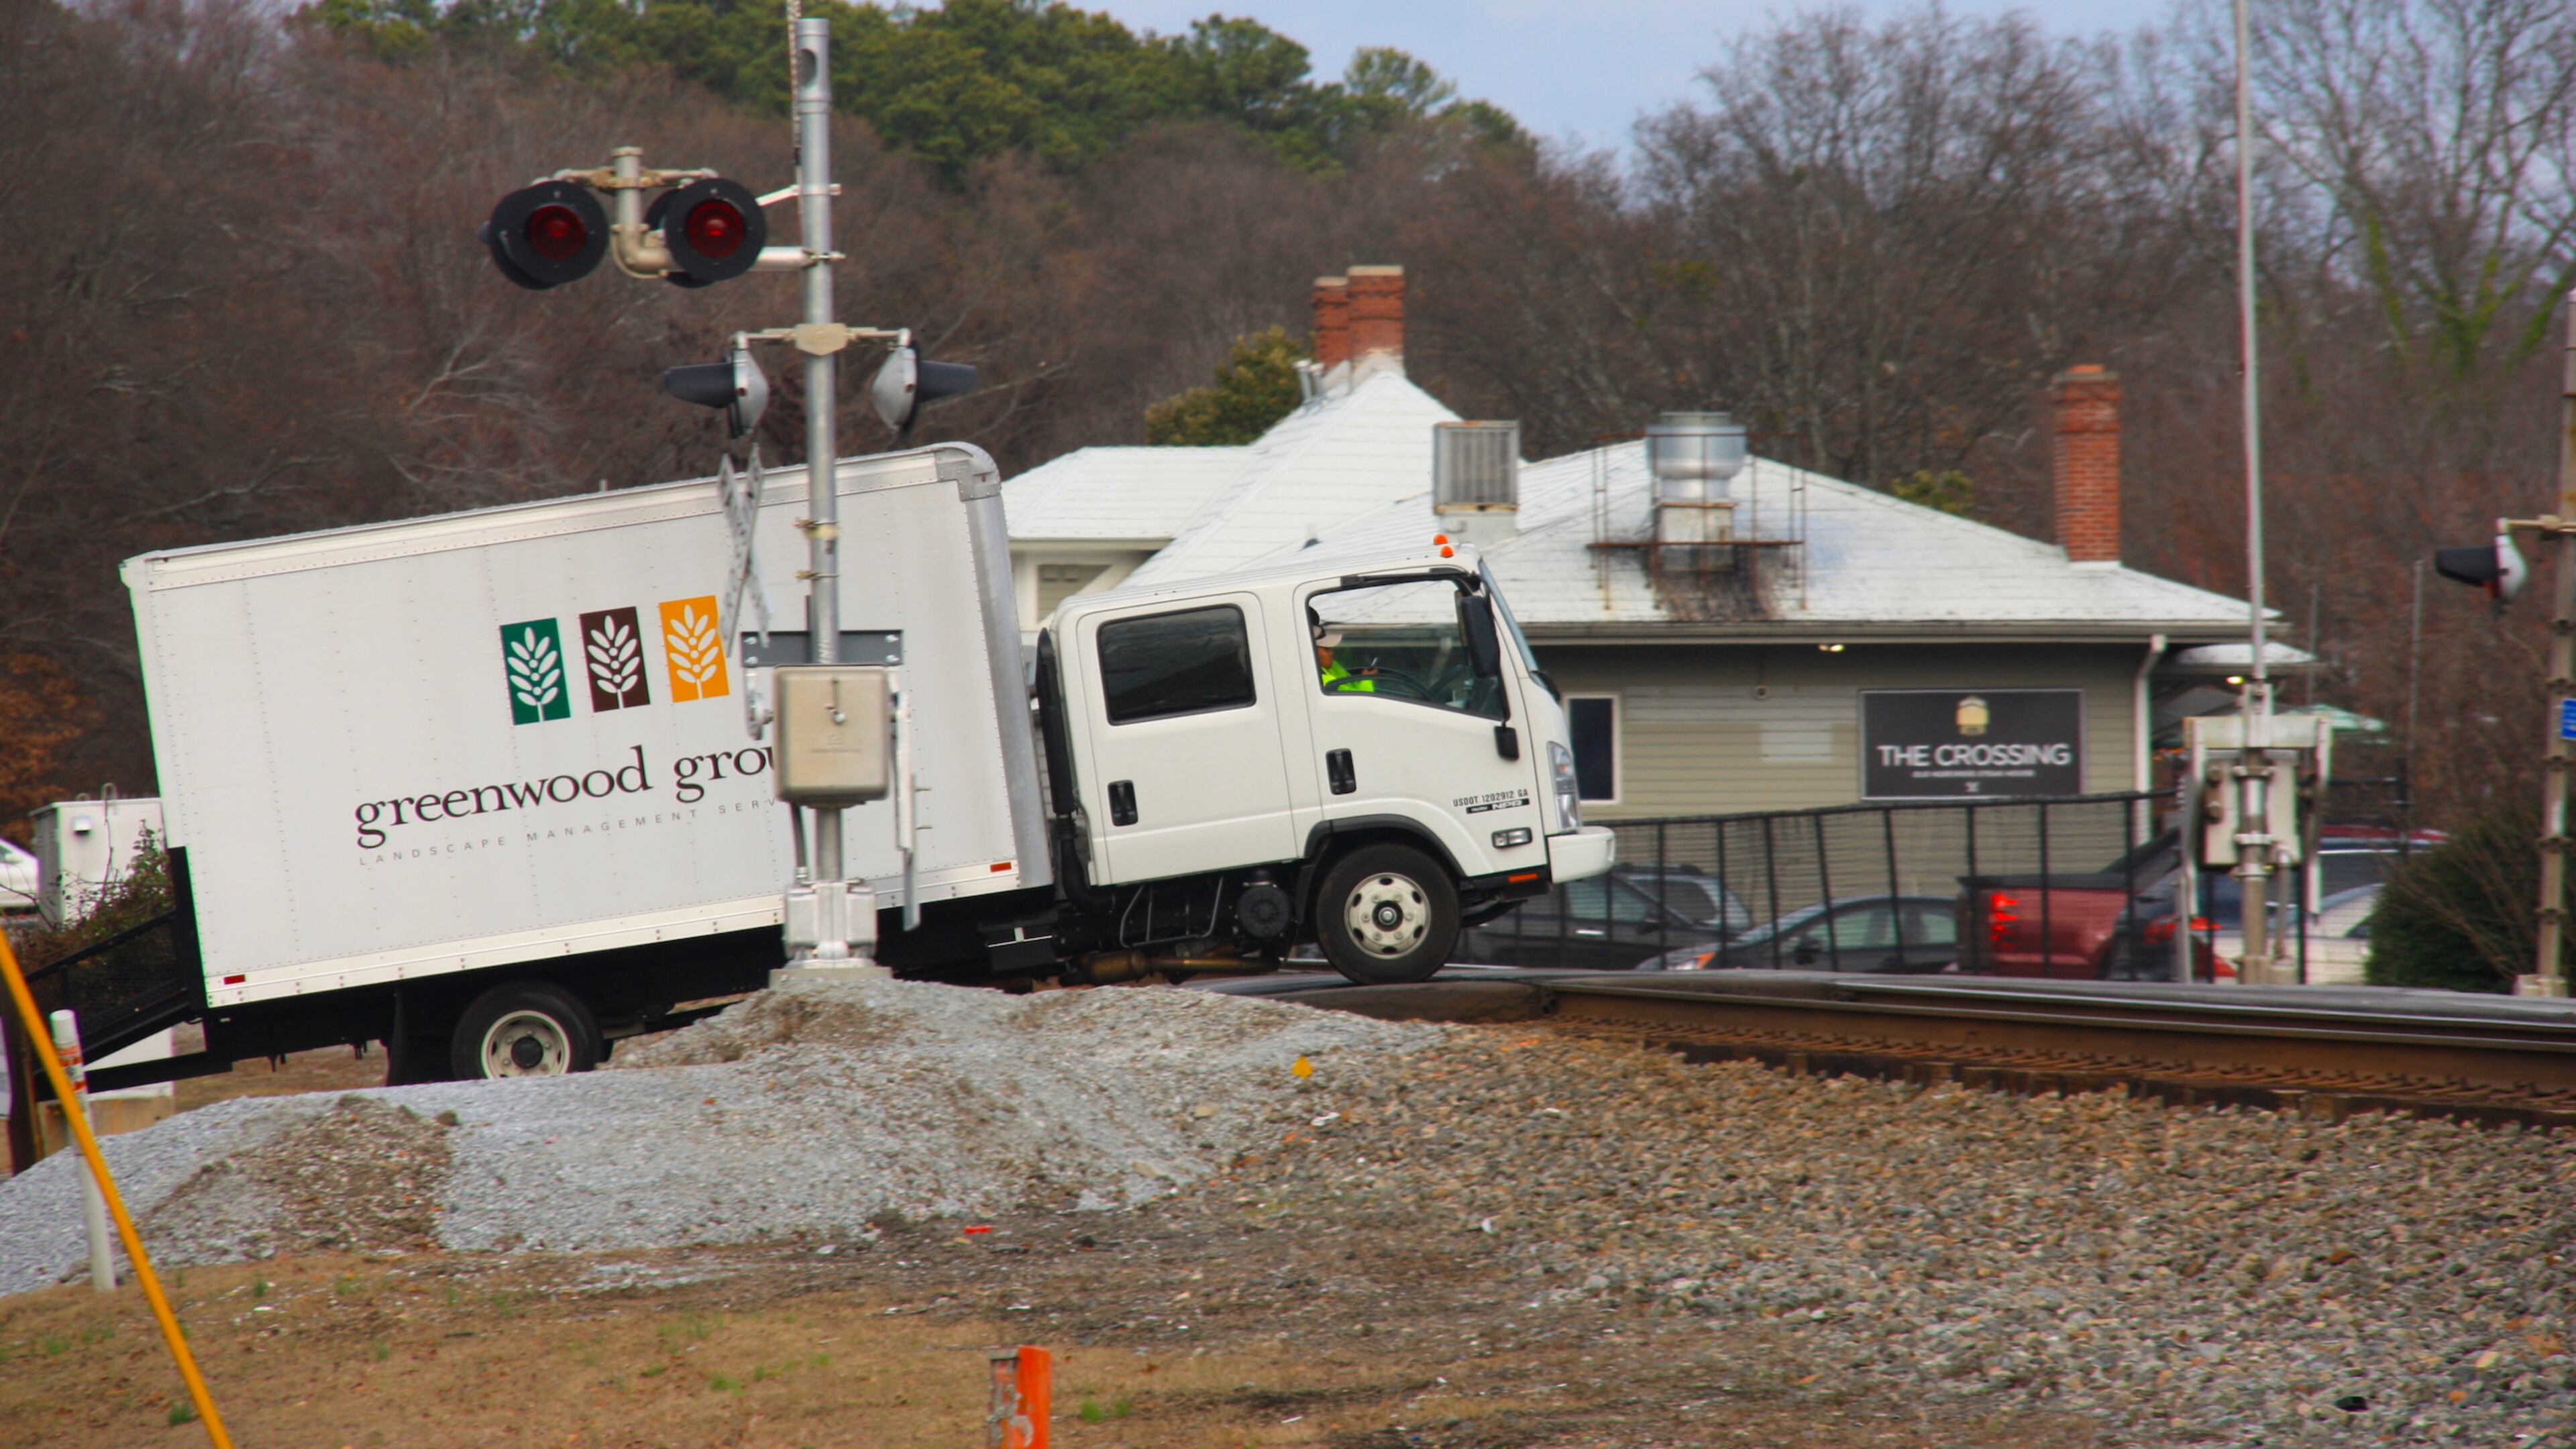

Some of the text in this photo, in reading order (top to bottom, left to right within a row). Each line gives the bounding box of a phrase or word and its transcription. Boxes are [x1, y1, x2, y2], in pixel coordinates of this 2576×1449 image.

[1877, 743, 2072, 767] THE CROSSING
[354, 744, 654, 849] greenwood
[1452, 789, 1528, 807] USDOT 1202912 GA
[1491, 800, 1522, 810] NPR
[359, 798, 775, 866] LANDSCAPE MANAGEMENT SERV
